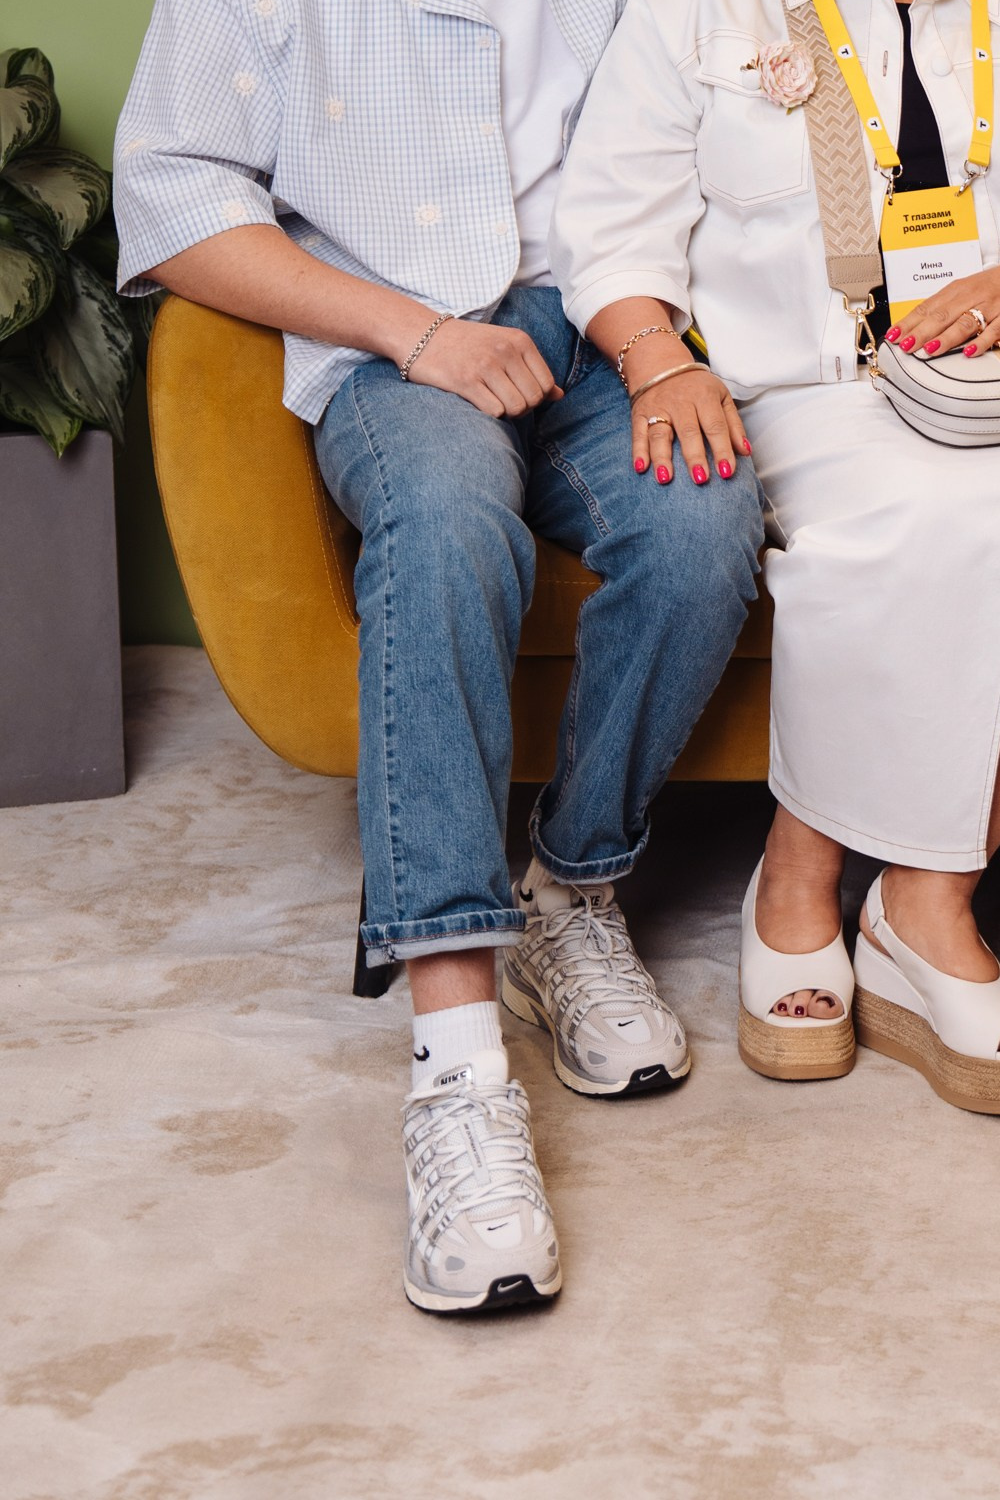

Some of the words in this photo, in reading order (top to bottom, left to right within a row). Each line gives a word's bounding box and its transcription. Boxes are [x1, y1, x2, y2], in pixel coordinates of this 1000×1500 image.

[903, 214, 909, 222] Т
[911, 210, 951, 221] глазами
[903, 219, 955, 234] родителей
[920, 262, 943, 270] Инна
[913, 271, 953, 281] Спицына
